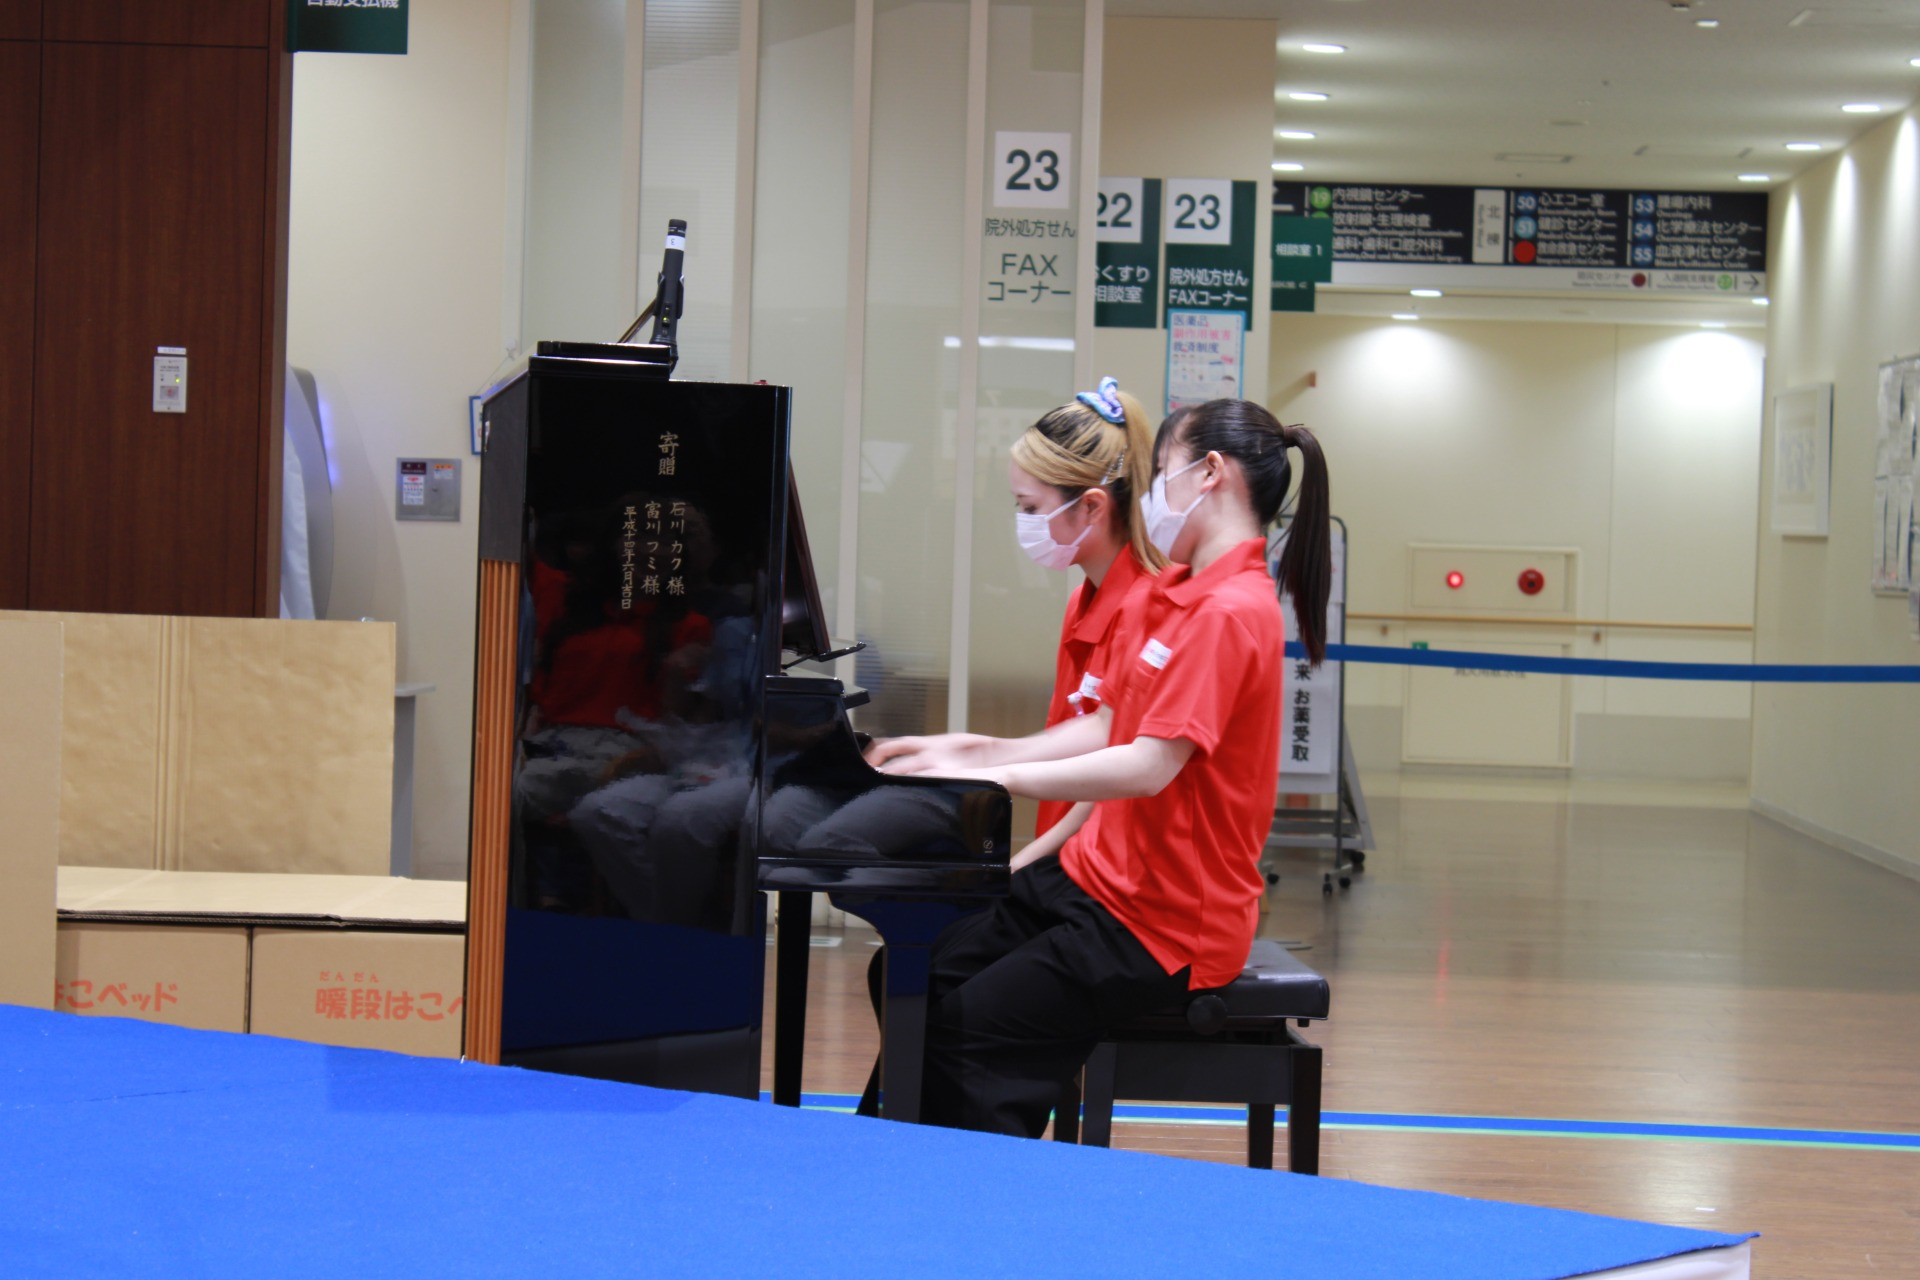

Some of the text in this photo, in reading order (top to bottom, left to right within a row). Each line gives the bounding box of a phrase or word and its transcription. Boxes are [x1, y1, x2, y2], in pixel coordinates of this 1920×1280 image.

[1005, 148, 1060, 192] 23
[1173, 193, 1221, 230] 23
[985, 217, 1076, 238] 院外処方せん
[1001, 253, 1058, 277] FAX
[1094, 265, 1150, 283] くすり
[1169, 267, 1249, 287] 院外処方せん
[987, 280, 1072, 303] コーナー
[1168, 290, 1248, 306] FAXコーナー
[658, 430, 680, 476] 寄贈
[1291, 688, 1312, 762] お薬受取
